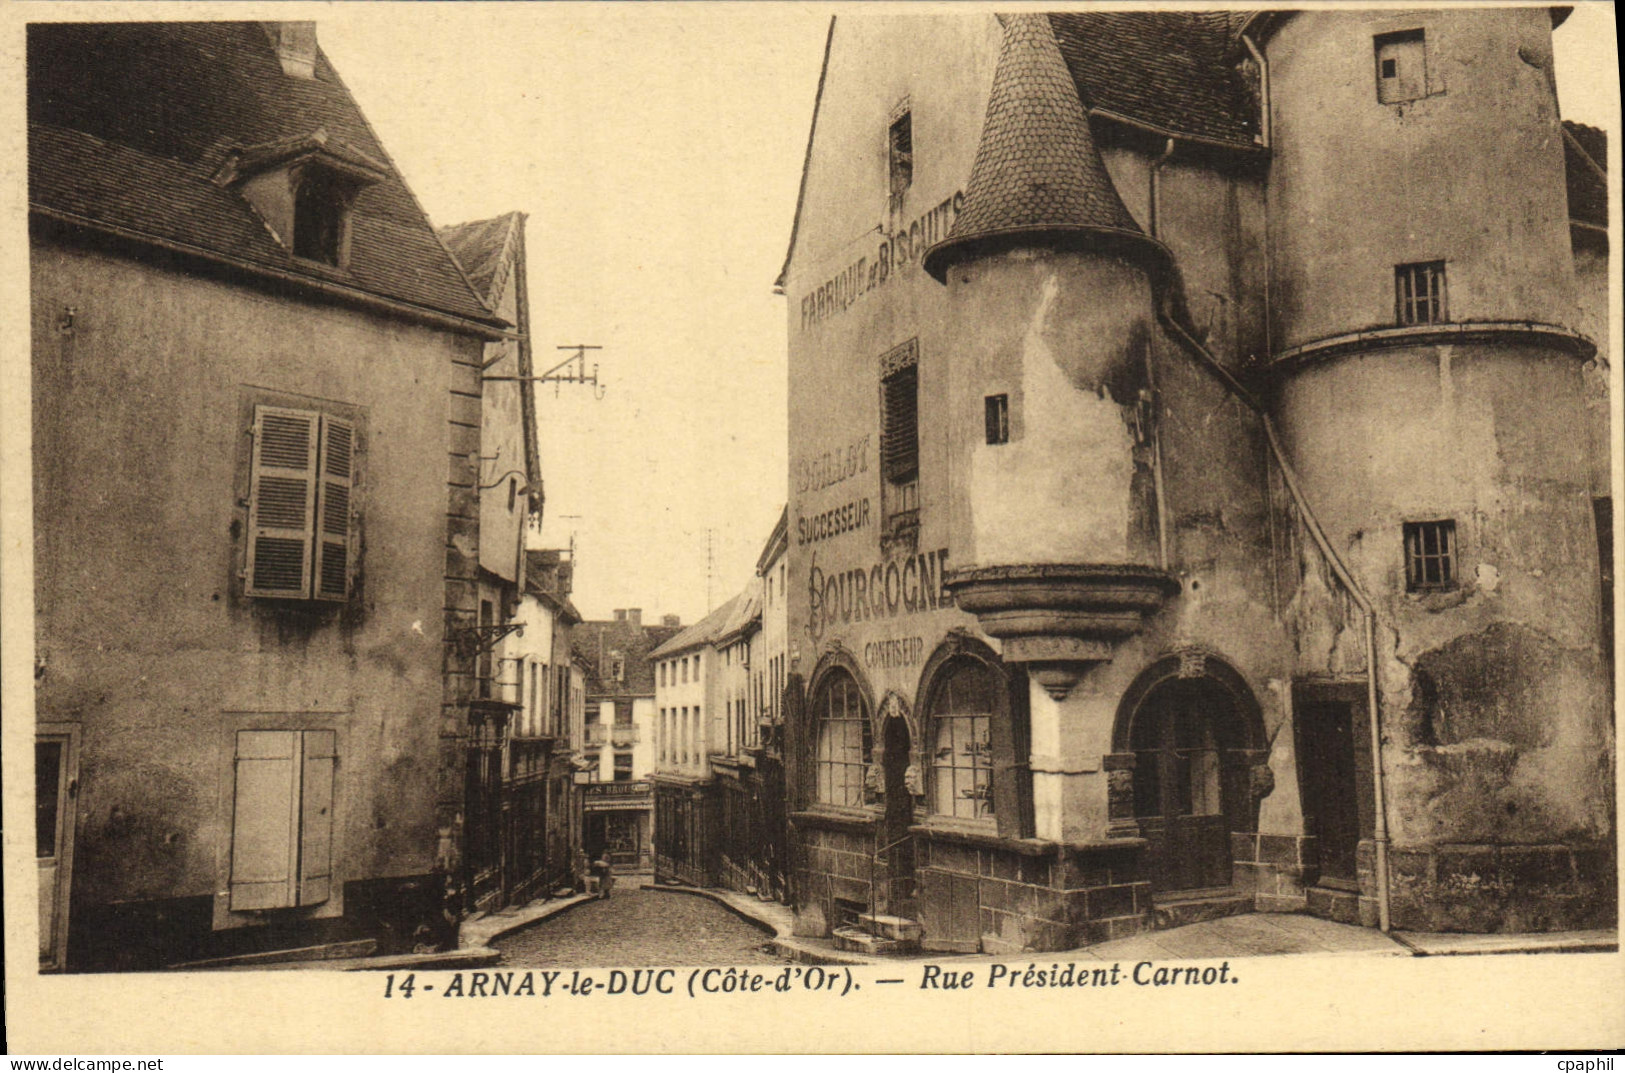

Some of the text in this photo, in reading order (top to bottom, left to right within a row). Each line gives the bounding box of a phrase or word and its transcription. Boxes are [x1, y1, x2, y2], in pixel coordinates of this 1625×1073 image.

[801, 256, 866, 331] FABRIQUE
[798, 497, 870, 546] SUCCESSEUR
[865, 636, 923, 669] CONFISEUR
